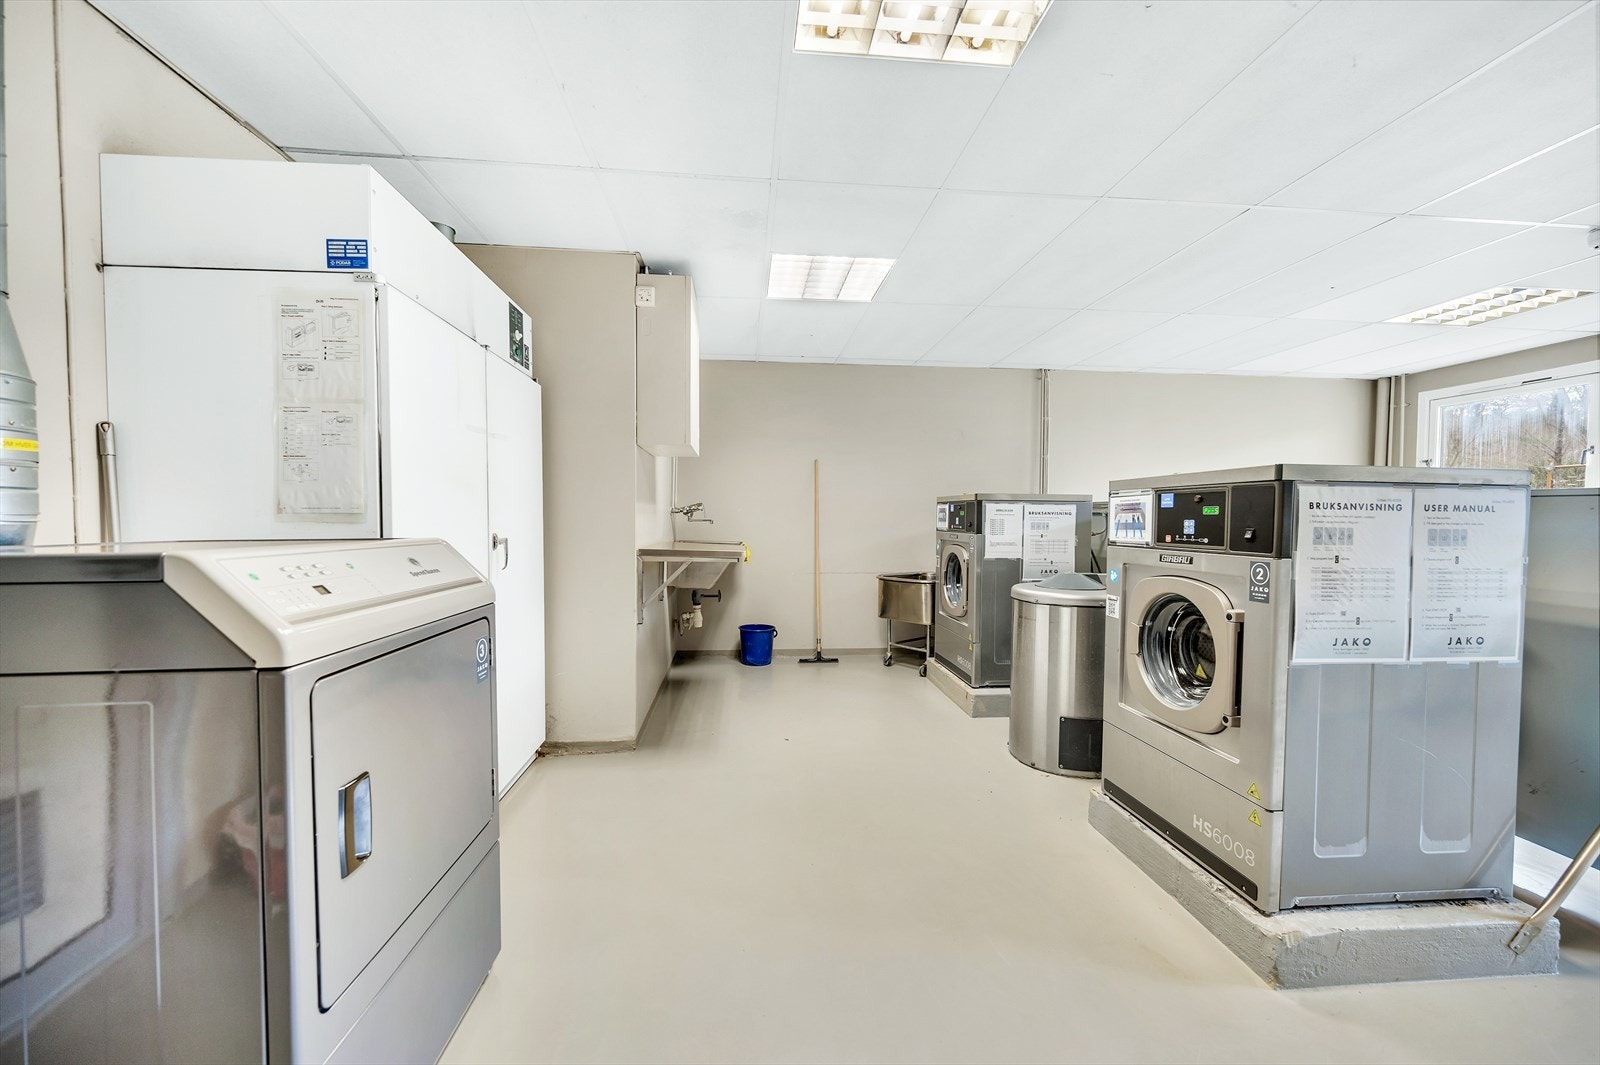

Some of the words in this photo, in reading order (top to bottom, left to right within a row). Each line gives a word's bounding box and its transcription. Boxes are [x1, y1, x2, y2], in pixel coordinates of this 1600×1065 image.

[1309, 502, 1403, 512] BRUKSANVISNING
[1424, 504, 1448, 512] USER
[1453, 505, 1495, 513] MANUAL
[1161, 555, 1190, 564] GIRBAU
[1256, 568, 1264, 580] 2
[1332, 637, 1371, 647] JAKO
[1448, 636, 1485, 646] JAKO
[479, 644, 485, 657] 3
[1193, 814, 1255, 867] HS6008
